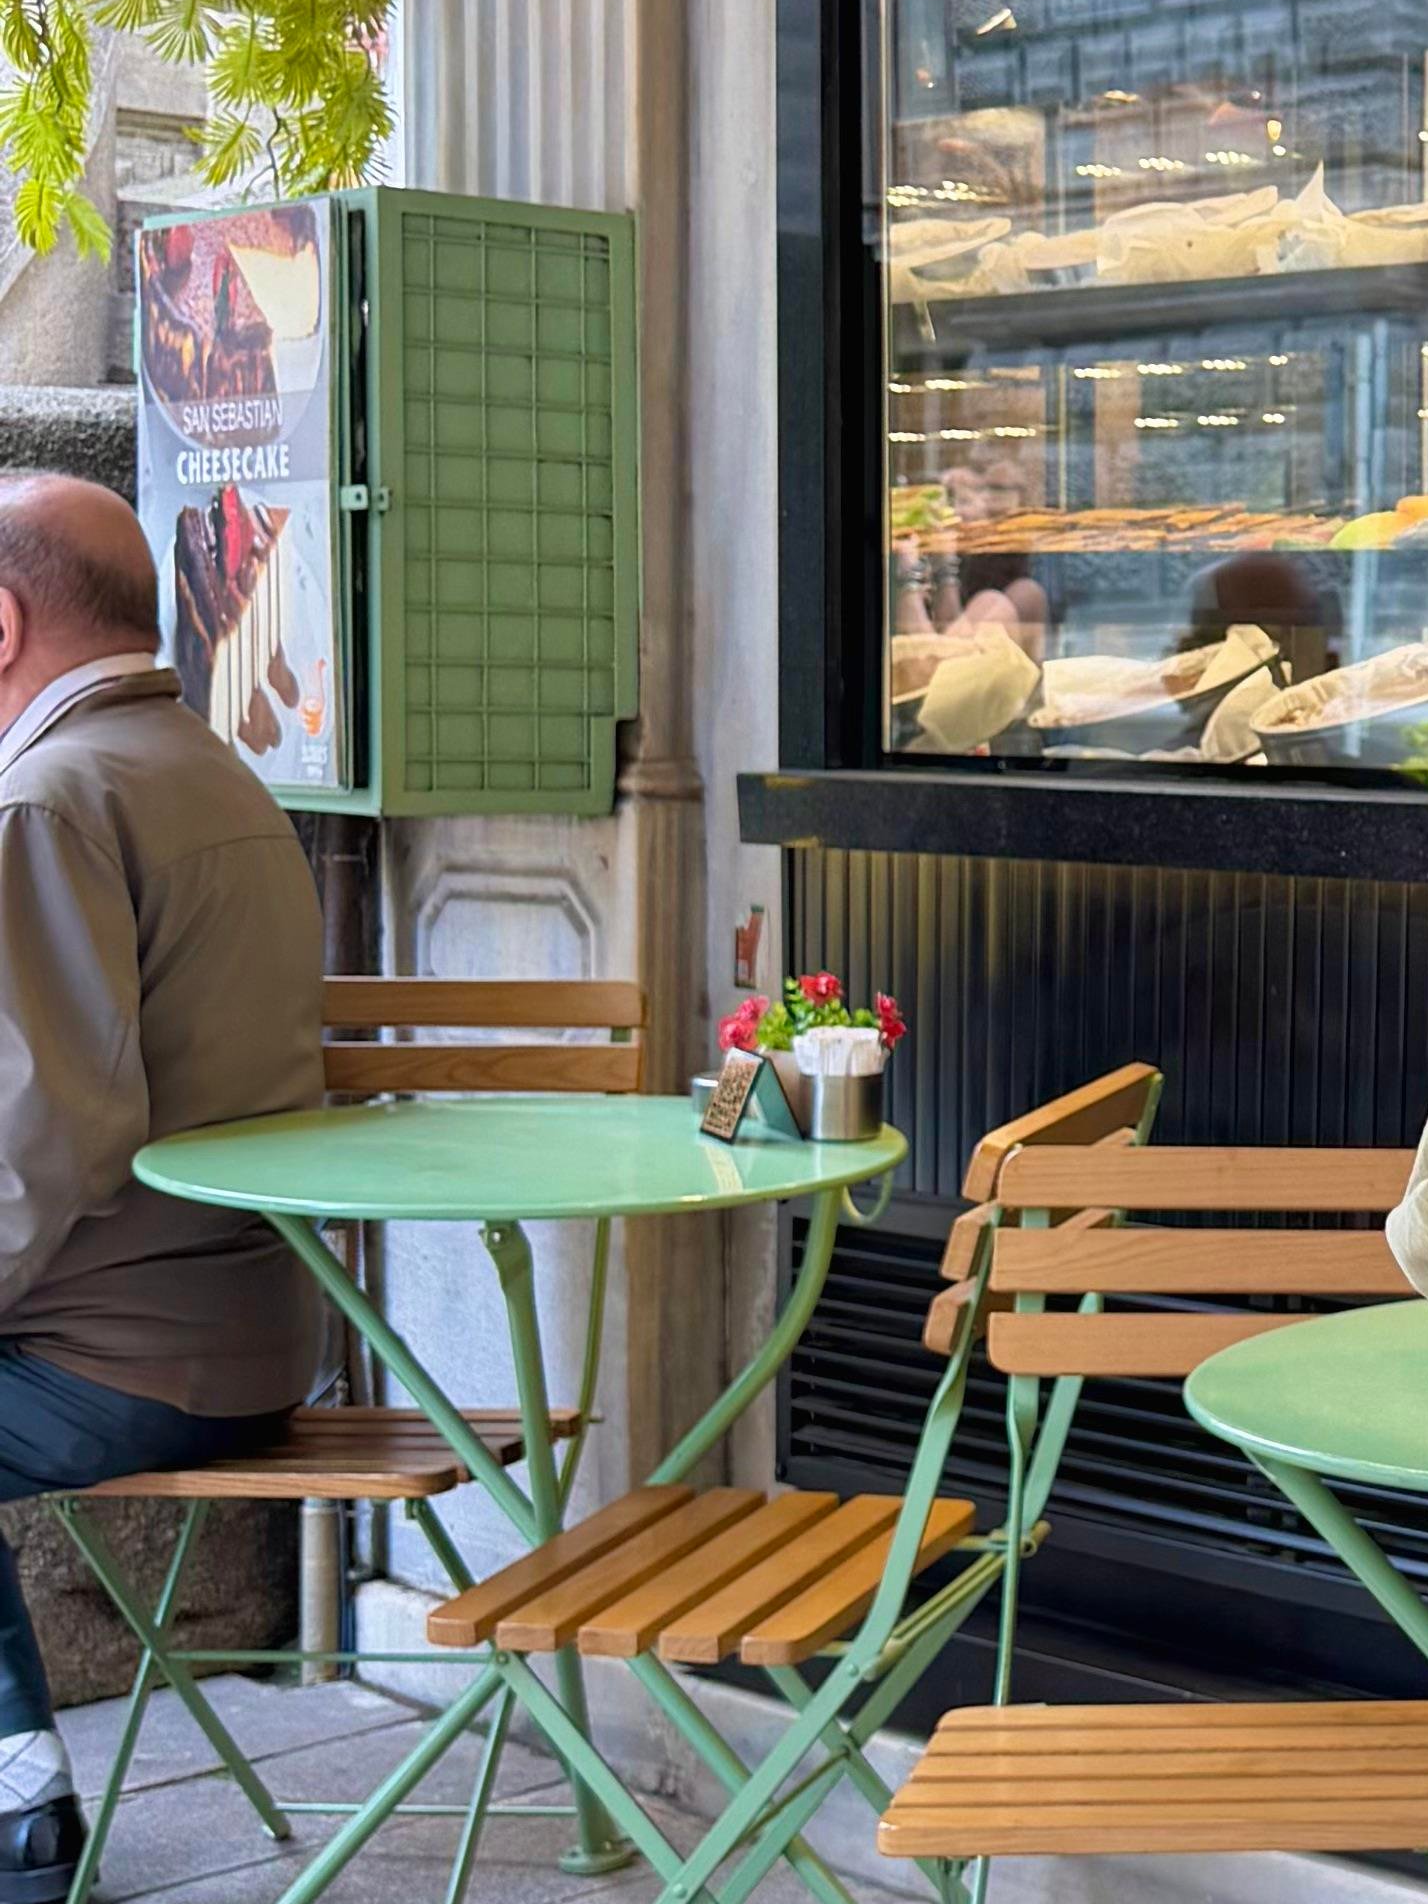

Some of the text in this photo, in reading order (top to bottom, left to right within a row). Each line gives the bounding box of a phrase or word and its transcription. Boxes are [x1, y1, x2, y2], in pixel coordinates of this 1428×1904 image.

[183, 399, 284, 435] SAN SEBASTIAN
[176, 444, 290, 485] CHEESECAKE
